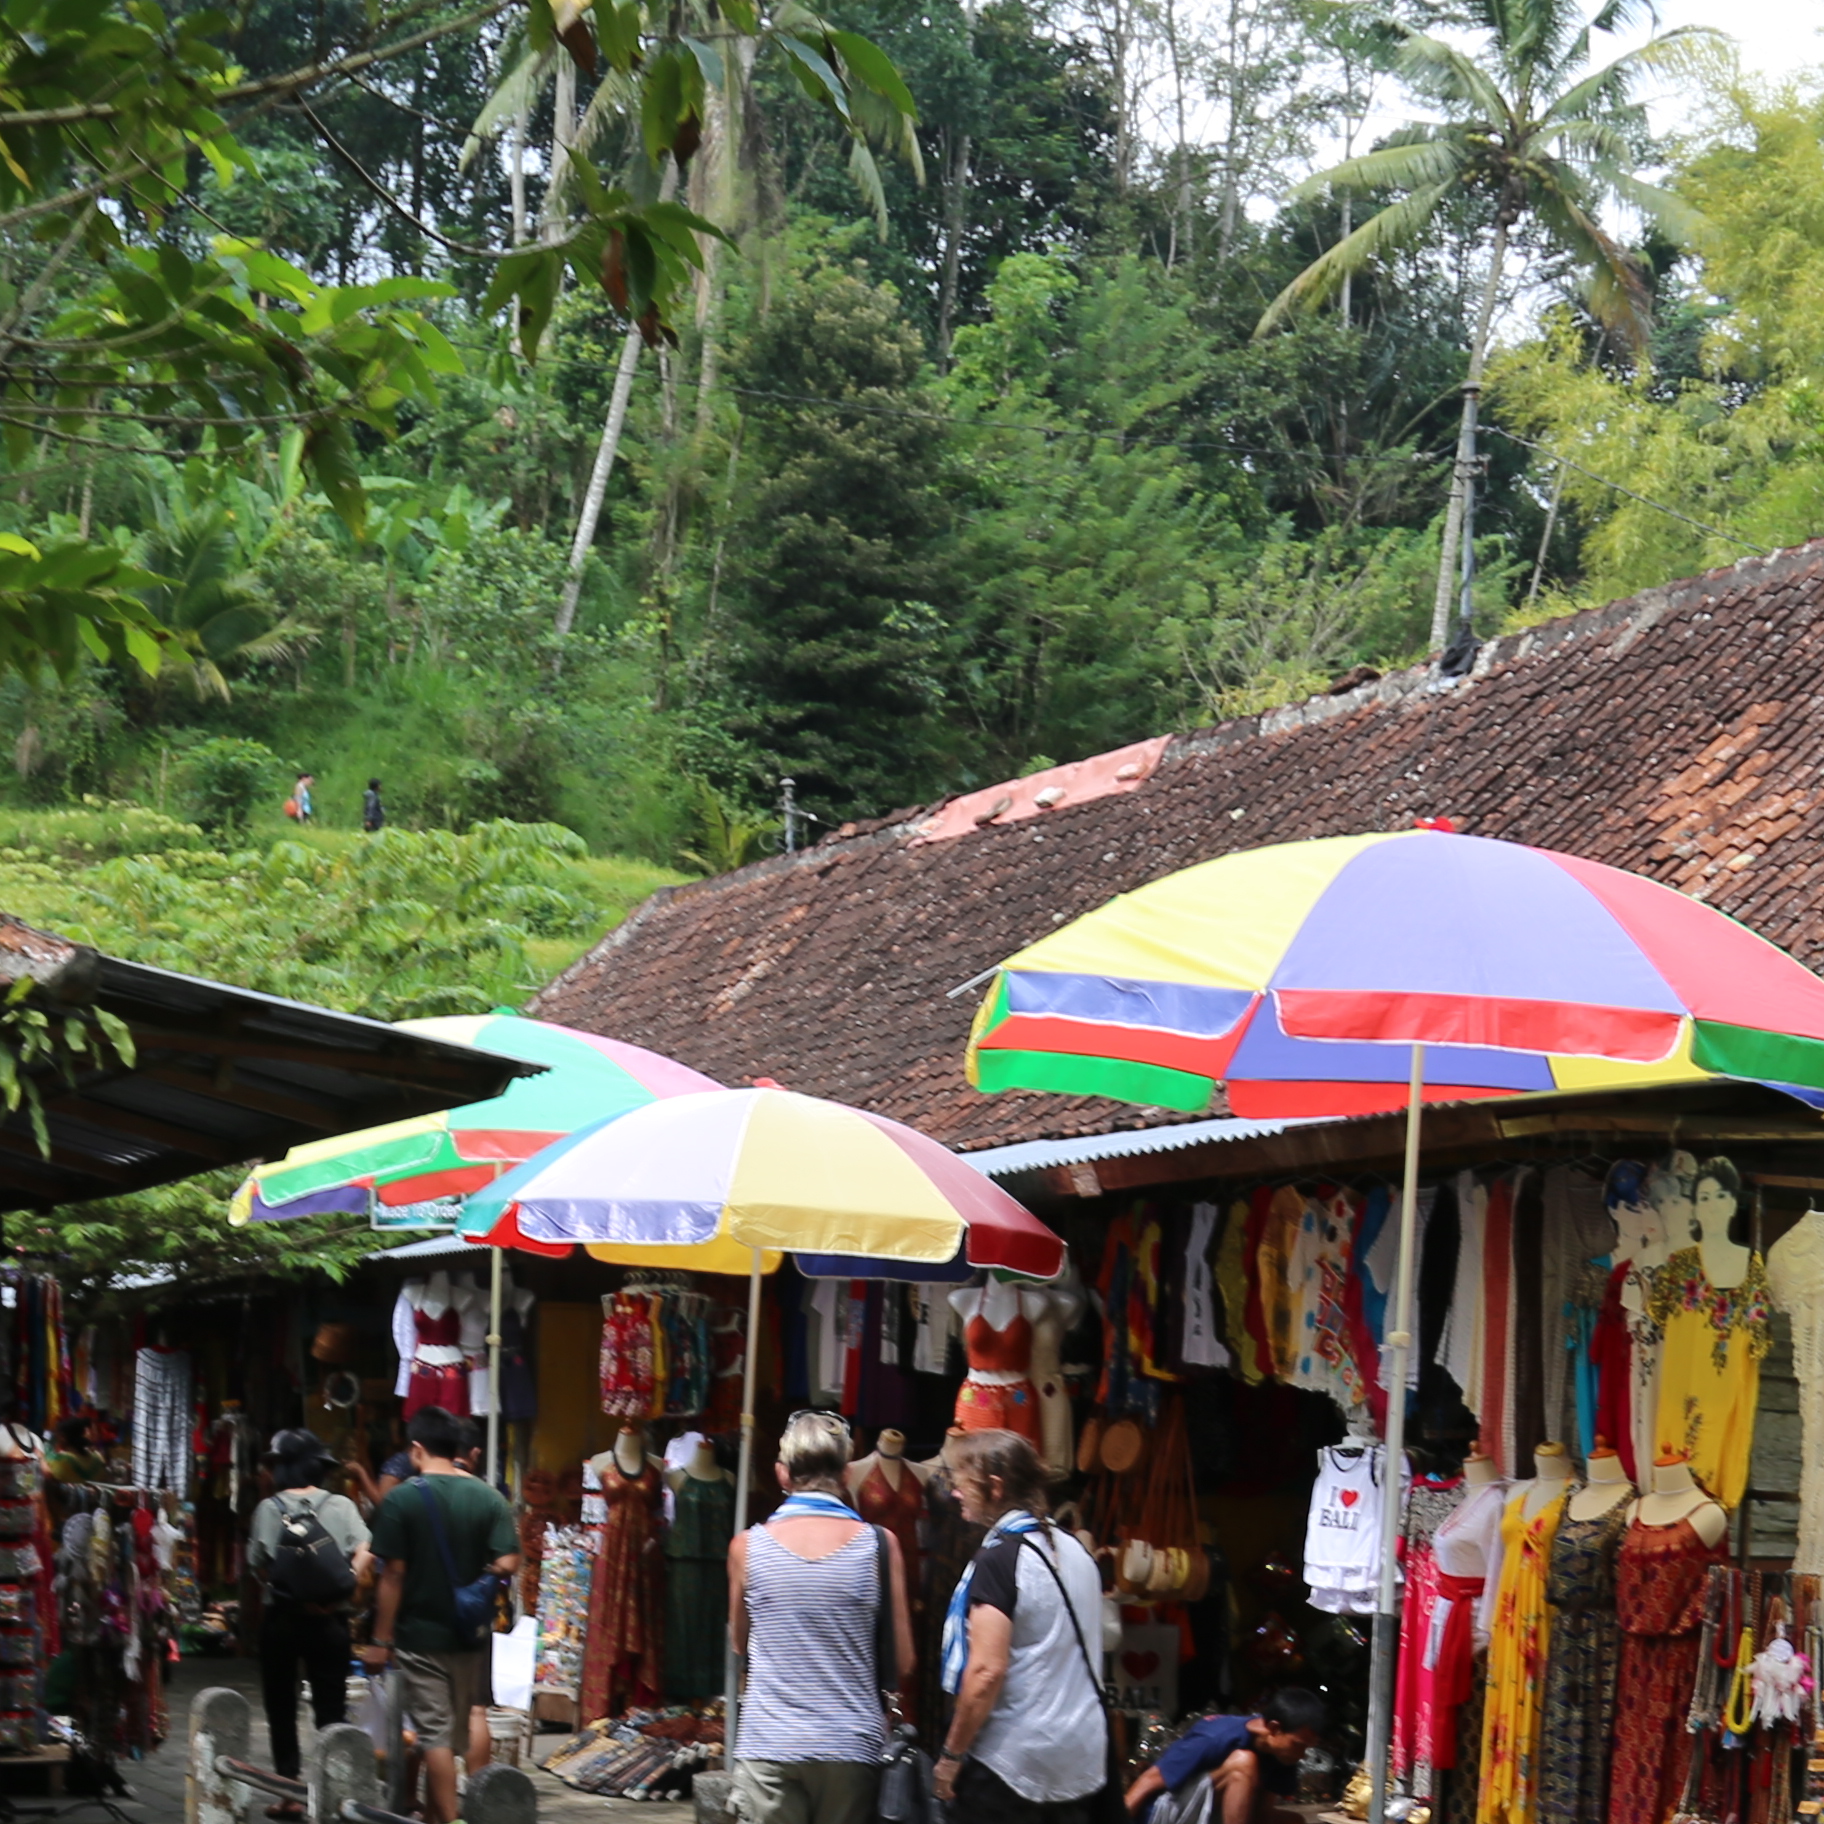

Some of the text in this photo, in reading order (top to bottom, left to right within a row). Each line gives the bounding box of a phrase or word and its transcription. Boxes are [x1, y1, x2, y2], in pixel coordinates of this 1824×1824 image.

[1328, 1485, 1340, 1507] I
[1319, 1508, 1361, 1531] BALI
[1104, 1686, 1162, 1709] BALI
